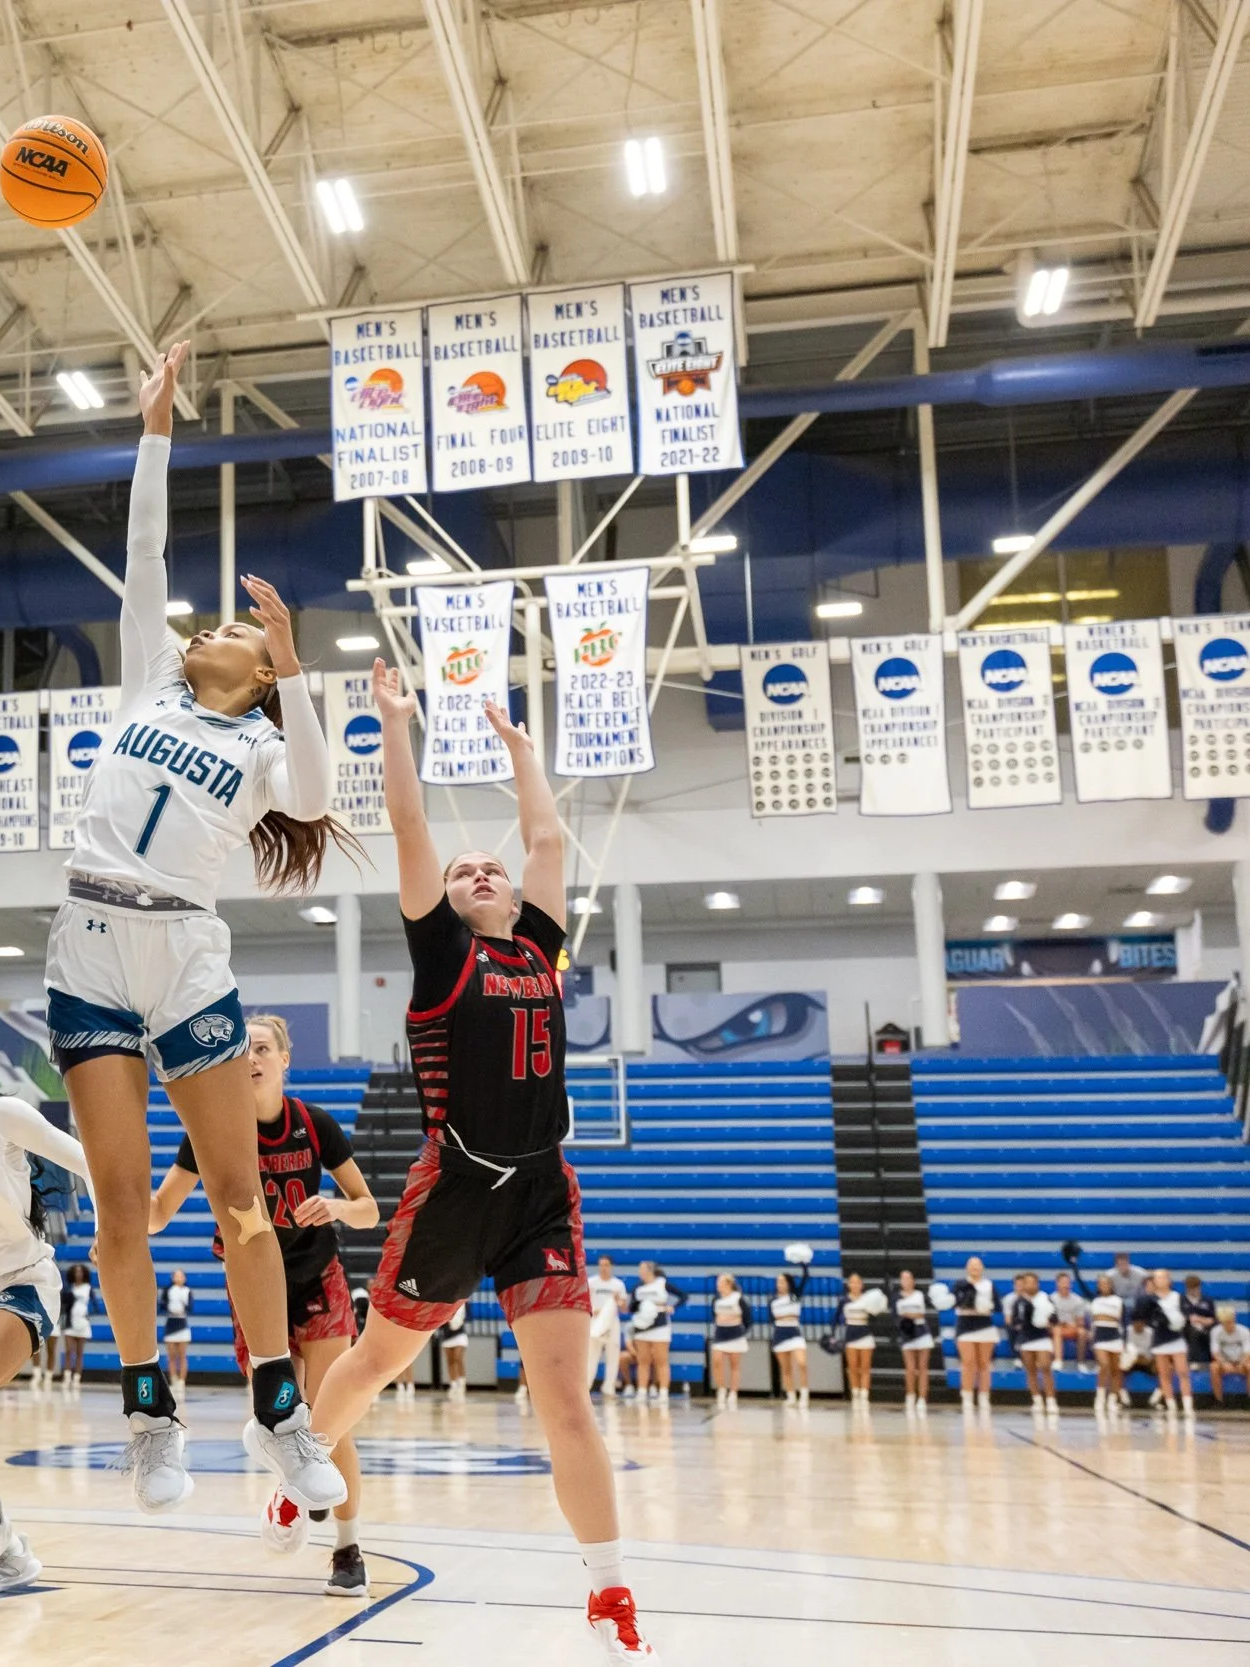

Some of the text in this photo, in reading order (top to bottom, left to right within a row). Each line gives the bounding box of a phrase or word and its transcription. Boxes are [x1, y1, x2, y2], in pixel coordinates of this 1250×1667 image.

[15, 147, 69, 177] NCAA
[660, 285, 701, 304] MEN'S
[455, 311, 497, 331] MEN'S
[554, 300, 598, 321] MEN'S
[639, 305, 724, 329] BASKETBALL
[356, 321, 397, 340] MEN'S
[533, 326, 621, 349] BASKETBALL
[334, 341, 421, 366] BASKETBALL
[434, 335, 518, 361] BASKETBALL
[655, 403, 720, 422] NATIONAL
[335, 421, 422, 443] NATIONAL
[436, 425, 526, 450] FINAL FOUR
[536, 416, 626, 441] ELITE EIGHT
[661, 425, 716, 445] FINALIST
[337, 444, 420, 468] FINALIST
[552, 446, 613, 468] 2009-10
[661, 447, 720, 467] 2021-22
[451, 456, 514, 478] 2008-09
[350, 470, 409, 490] 2007-08
[577, 580, 618, 598] MEN'S
[556, 594, 641, 619] BASKETBALL
[425, 614, 505, 633] BASKETBALL
[571, 671, 634, 690] 2022-23
[477, 715, 493, 731] BE
[565, 707, 640, 728] CONFERENCE
[568, 727, 639, 748] TOURNAMENT
[753, 723, 825, 737] CHAMPIONSHIP
[433, 735, 506, 755] CONFERENCE
[113, 722, 243, 808] AUGUSTA
[433, 757, 507, 777] CHAMPIONS
[567, 747, 645, 767] CHAMPIONS
[338, 762, 383, 777] CENTRA
[333, 795, 385, 811] CHAMPIO
[133, 781, 174, 858] 1
[350, 812, 381, 827] 2005
[510, 1007, 552, 1080] 15
[265, 1178, 308, 1228] 20
